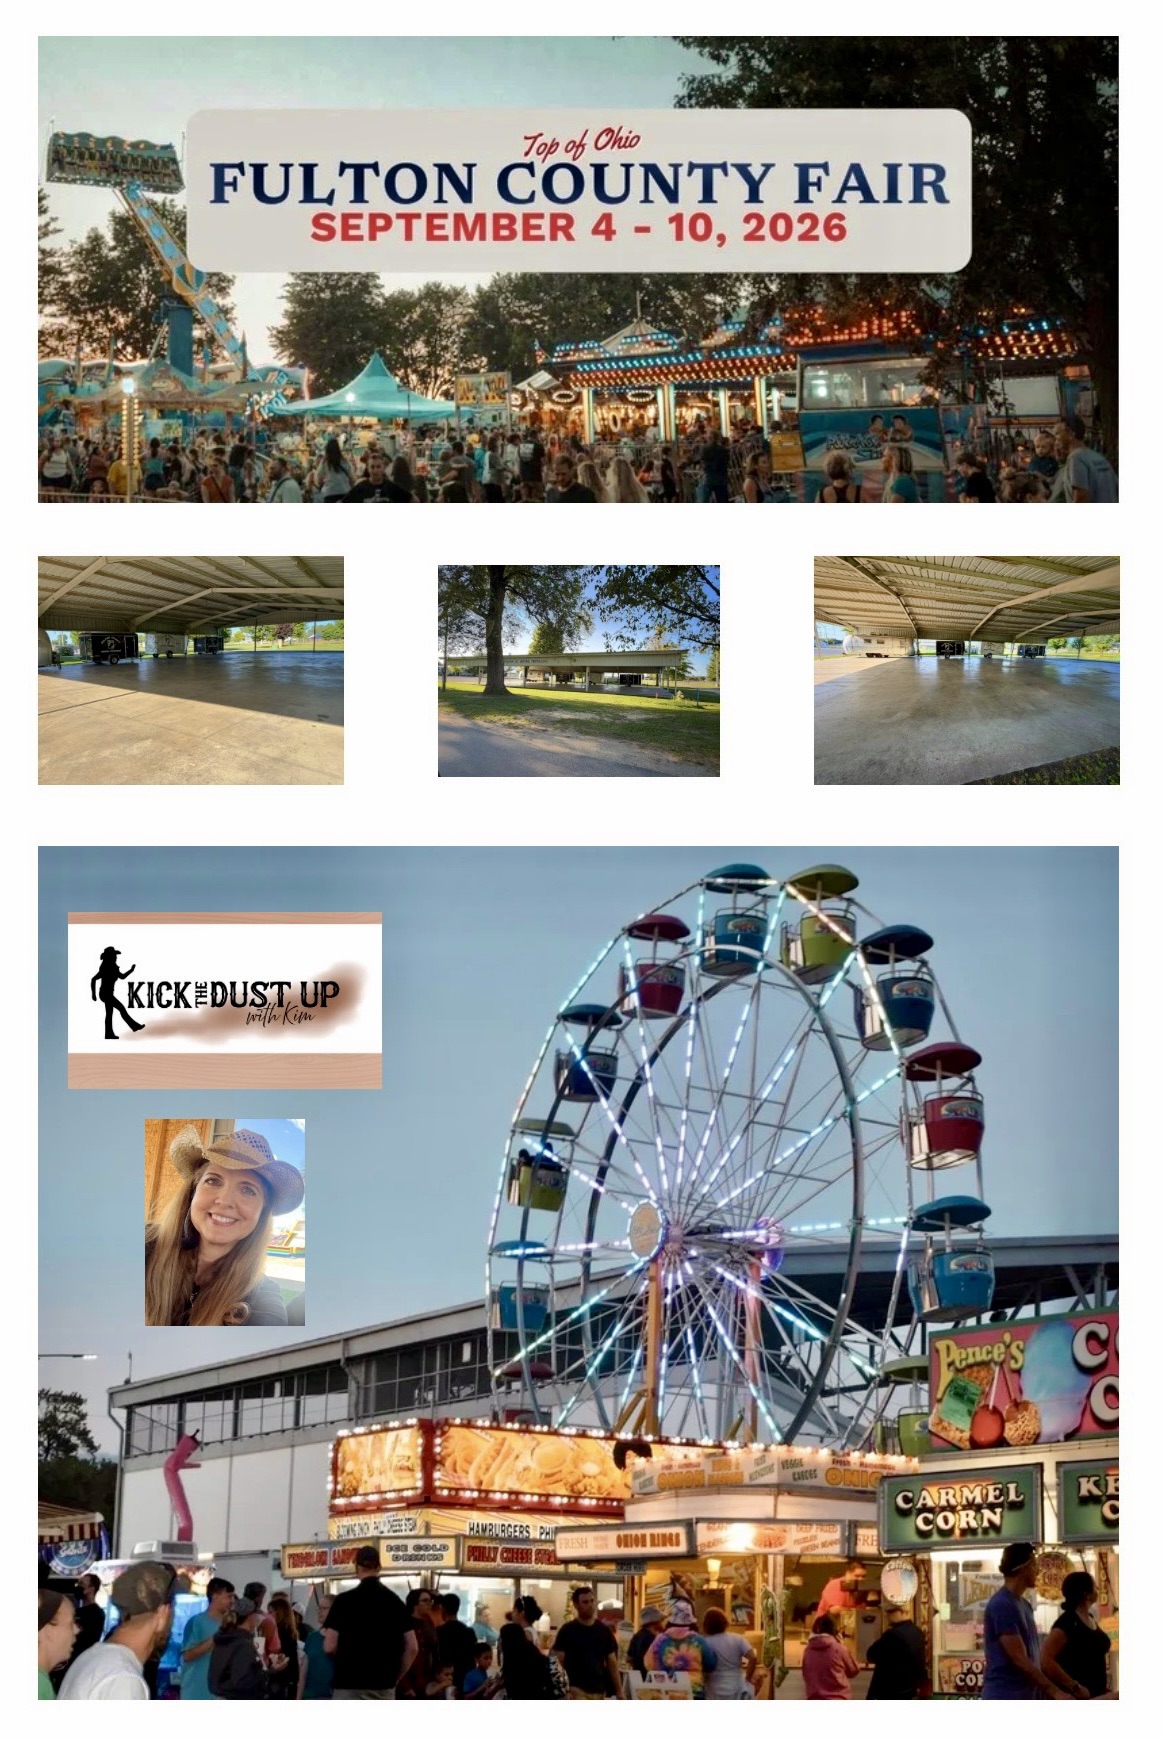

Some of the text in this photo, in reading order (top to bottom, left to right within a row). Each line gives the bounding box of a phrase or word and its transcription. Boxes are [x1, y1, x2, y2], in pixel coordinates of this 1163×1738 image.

[935, 1331, 1025, 1400] Pence's
[895, 1482, 1025, 1510] CARMEL
[915, 1508, 1003, 1532] CORN
[468, 1521, 531, 1539] HAMBURGERS
[386, 1544, 449, 1552] ICE COLD
[558, 1537, 588, 1549] FRESH
[616, 1532, 680, 1548] ONION RINGS
[467, 1545, 499, 1563] PHILLY
[500, 1546, 532, 1564] CHEESE
[962, 1660, 987, 1673] PO
